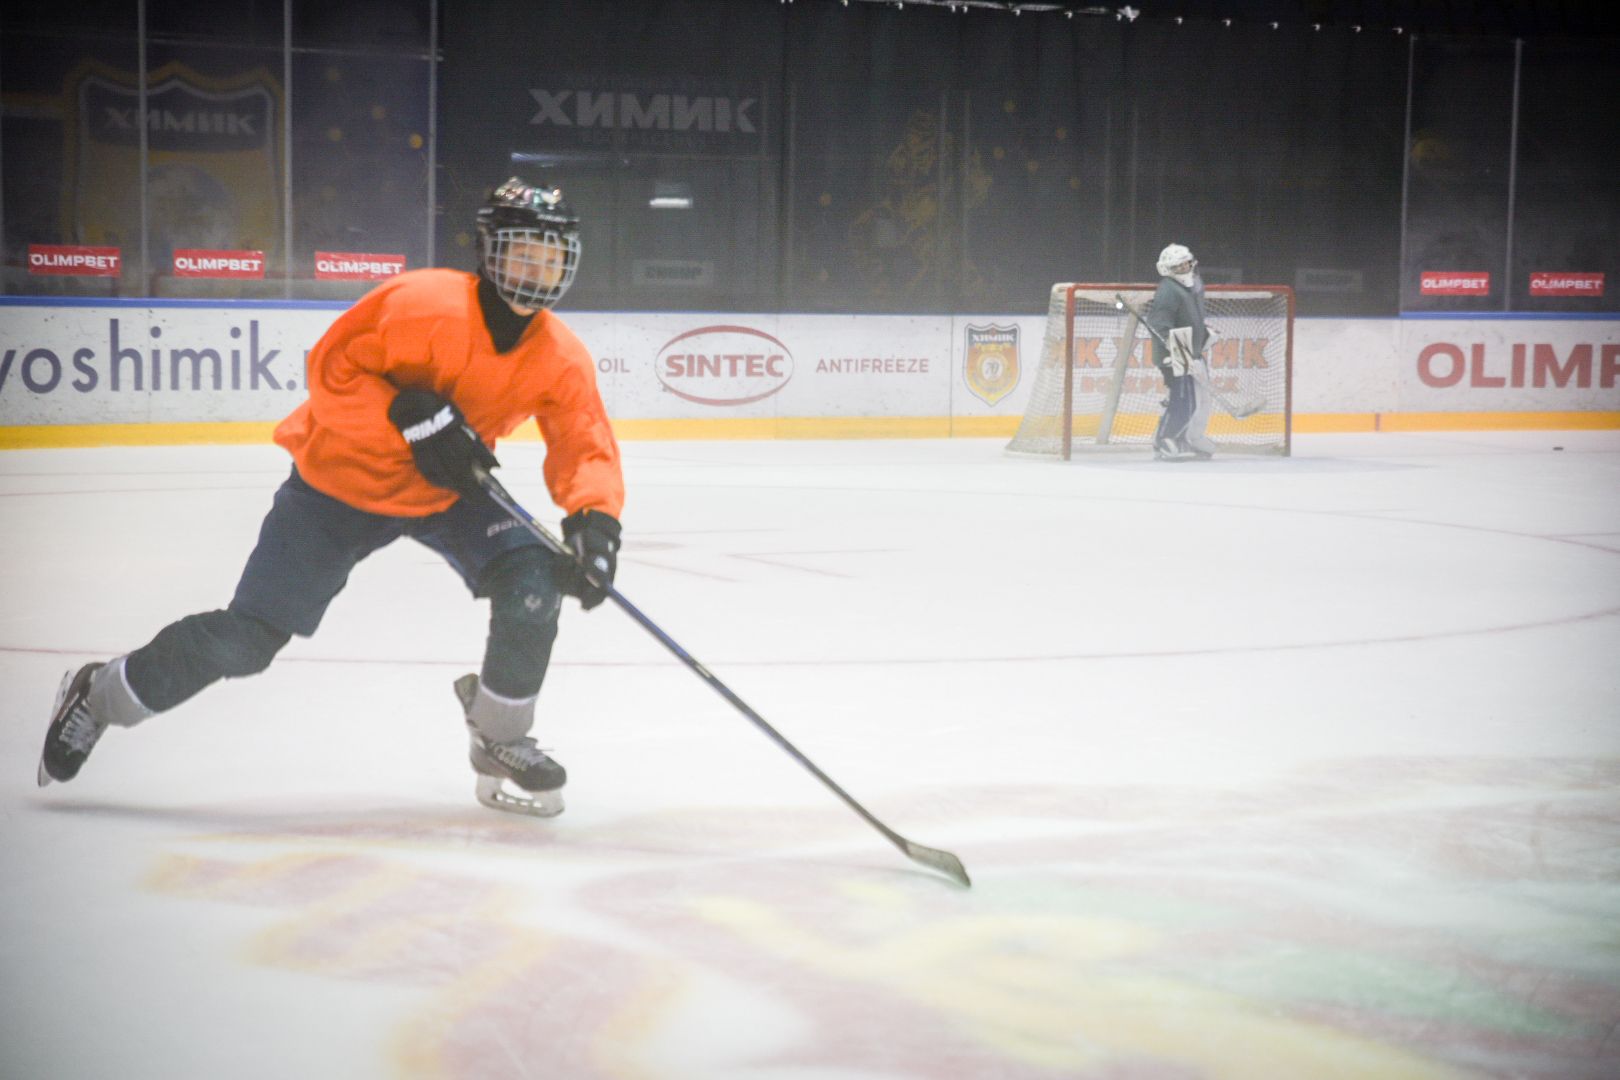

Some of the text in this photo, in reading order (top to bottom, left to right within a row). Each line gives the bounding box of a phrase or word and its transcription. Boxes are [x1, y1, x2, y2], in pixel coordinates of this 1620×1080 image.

[529, 88, 758, 133] ХИМИК
[103, 106, 256, 135] ХИМИК
[30, 253, 118, 269] OLIMPBET
[174, 256, 263, 273] OLIMPBET
[316, 259, 404, 275] OLIMPBET
[1421, 278, 1488, 290] OLIMPBET
[1530, 278, 1603, 290] OLIMPBET
[598, 358, 631, 374] OIL
[665, 353, 785, 379] SINTEC
[815, 357, 930, 374] ANTIFREEZE
